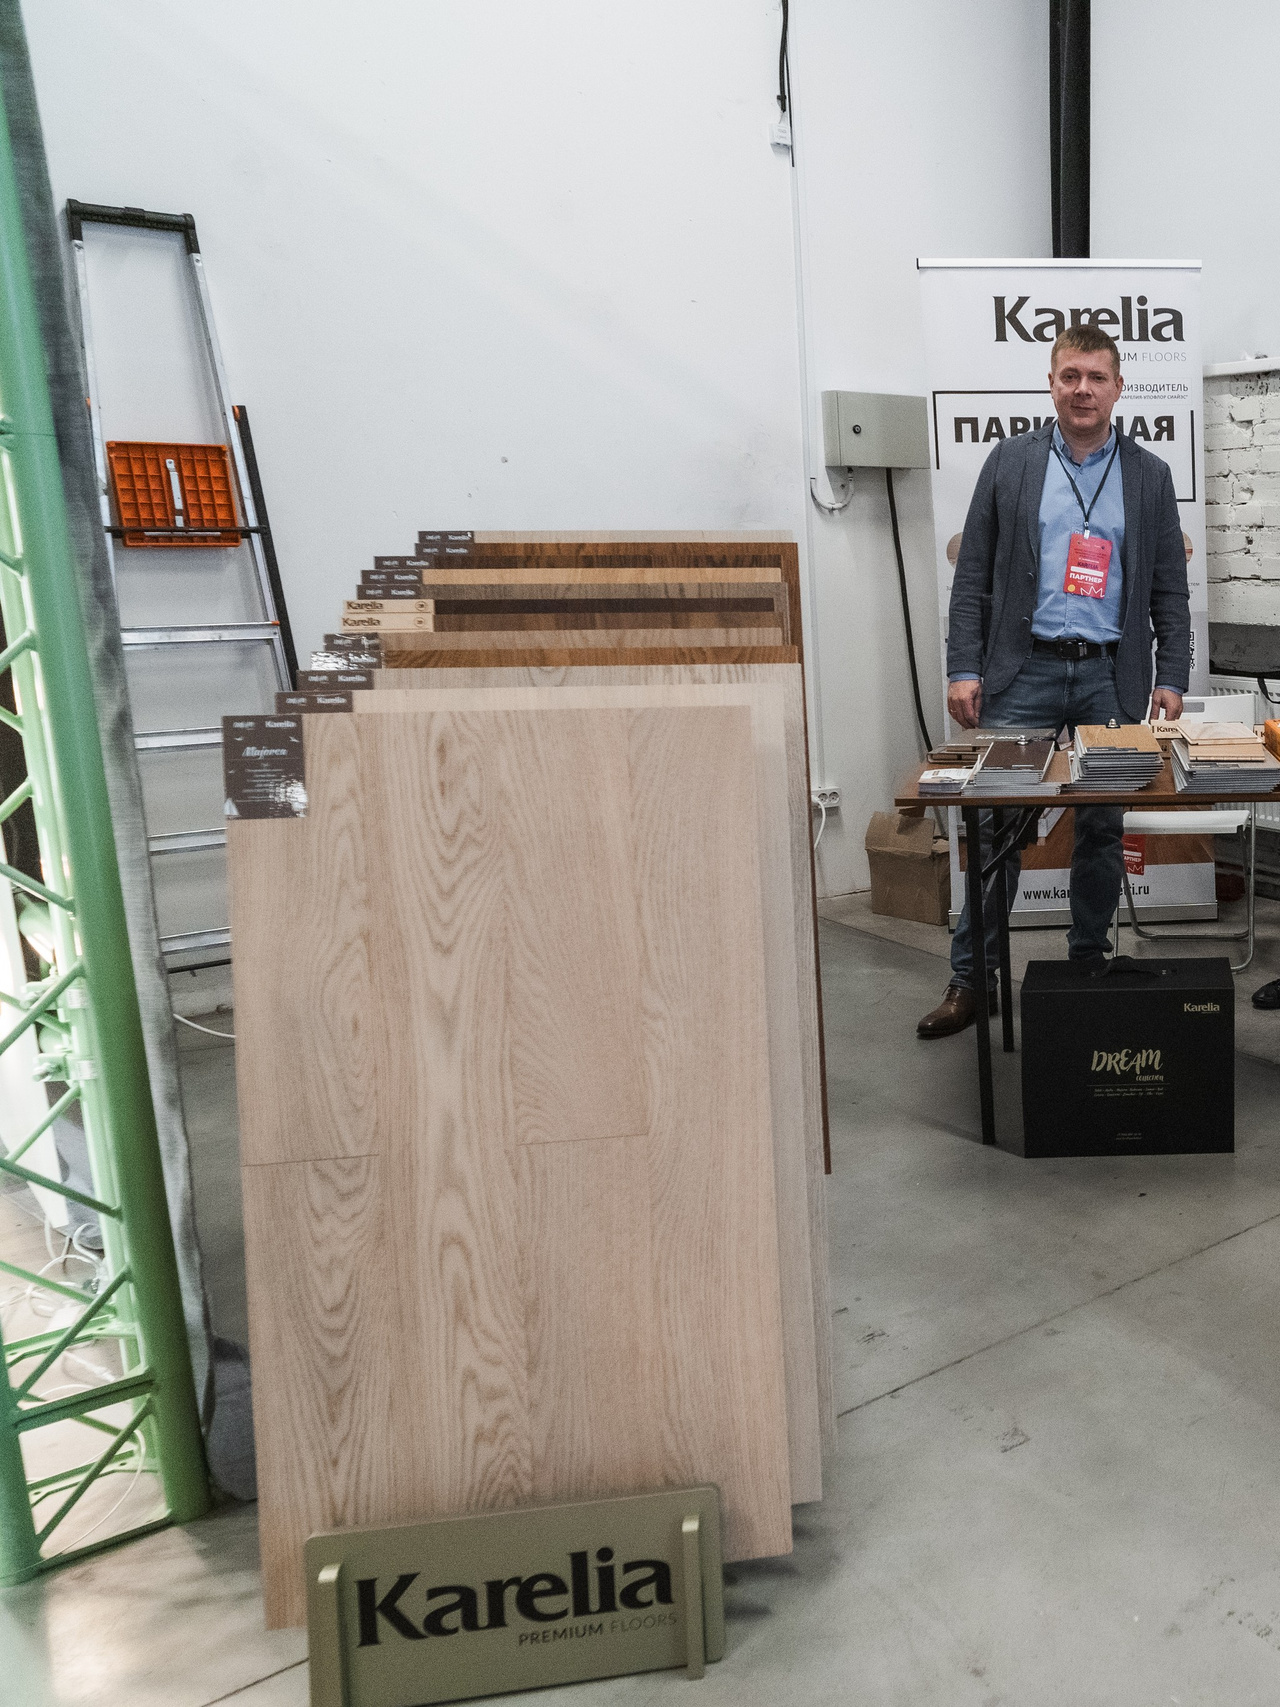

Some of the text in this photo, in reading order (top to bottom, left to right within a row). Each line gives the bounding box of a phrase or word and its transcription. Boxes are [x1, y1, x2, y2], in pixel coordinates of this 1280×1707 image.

[992, 295, 1186, 342] Karelia
[1142, 352, 1187, 362] FLOORS
[1122, 383, 1189, 393] ОИЗВОДИТЕЛЬ
[1070, 573, 1103, 583] ПАРТНЕР
[1184, 1003, 1220, 1012] Karelia
[1091, 1049, 1163, 1075] DREAM
[354, 1546, 675, 1648] Karelia
[517, 1612, 678, 1647] PREMIUM FLOORS
